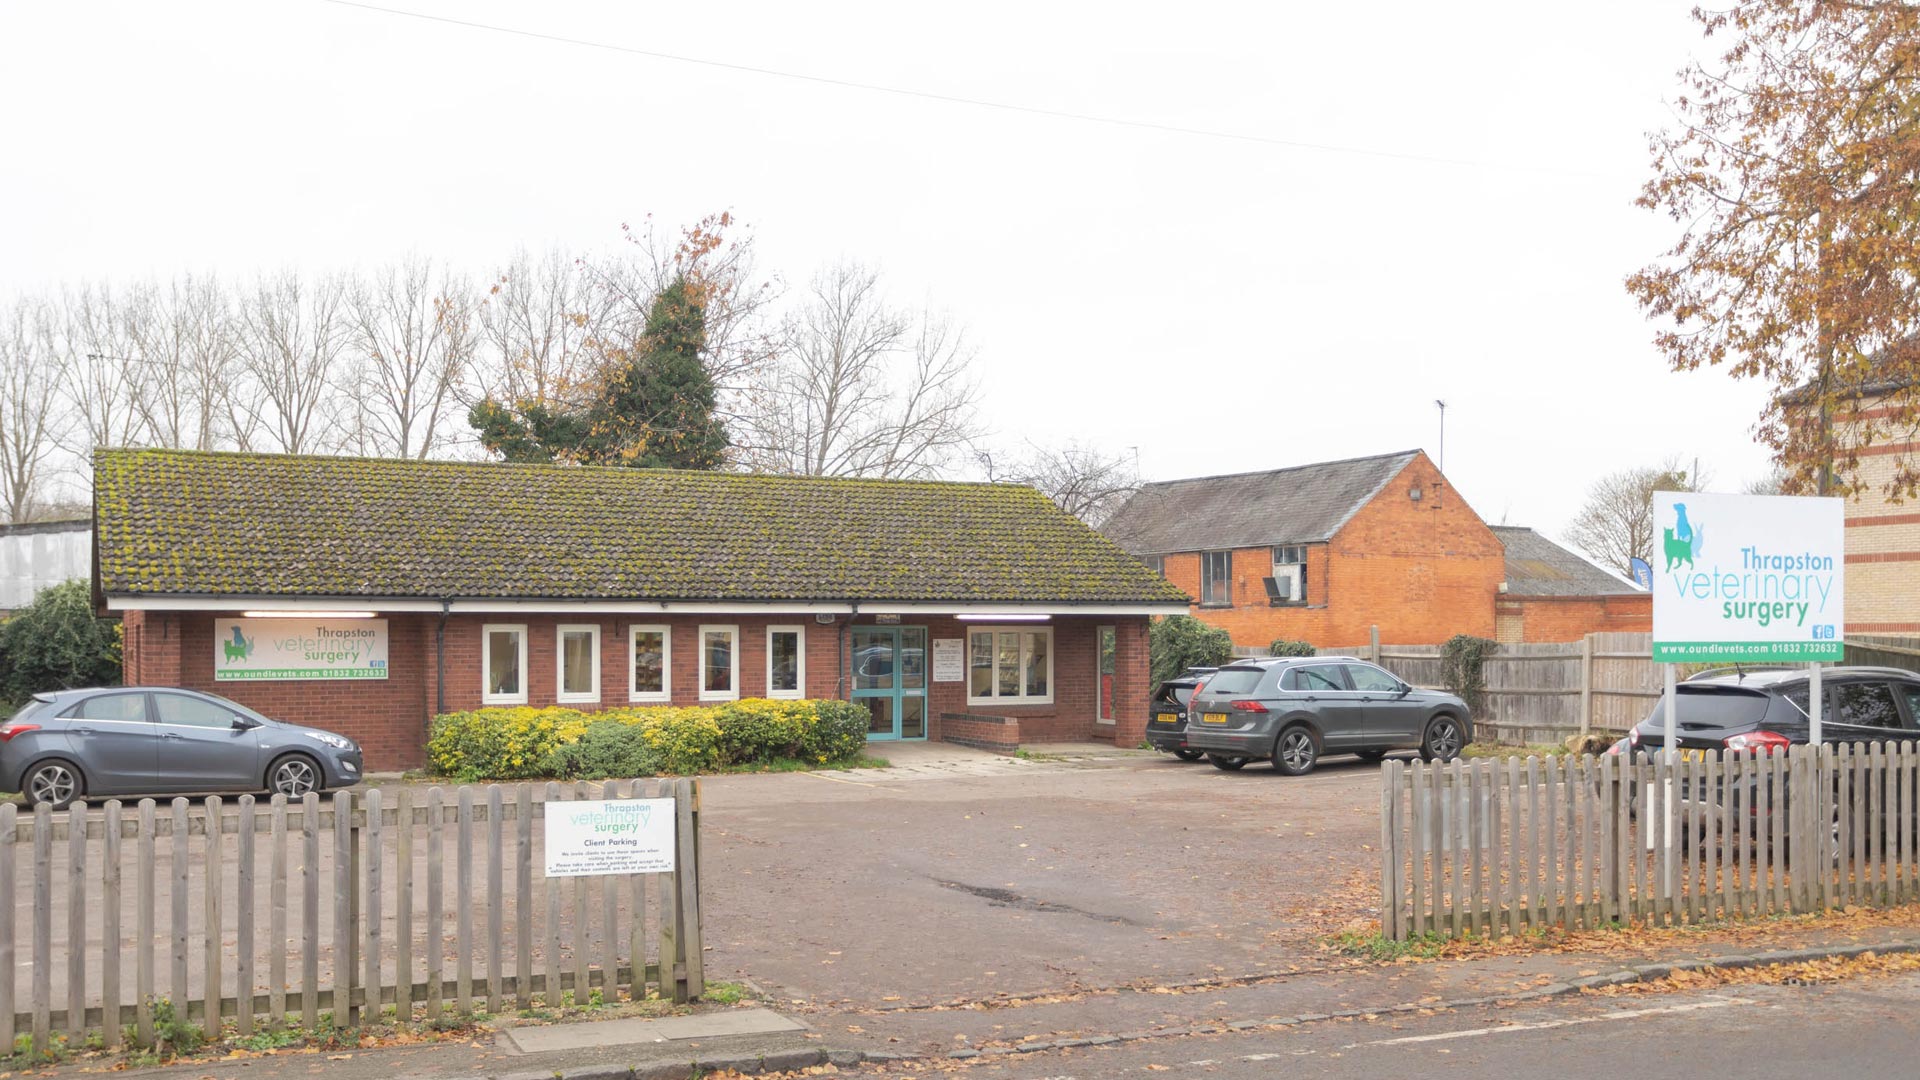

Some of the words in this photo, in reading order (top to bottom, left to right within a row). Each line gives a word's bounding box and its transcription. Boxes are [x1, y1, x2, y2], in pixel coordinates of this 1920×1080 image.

[1741, 546, 1833, 574] Thrapston
[1674, 565, 1833, 613] veterinary
[1723, 601, 1809, 627] surgery
[316, 626, 376, 639] Thrapston
[273, 634, 376, 658] veterinary
[1661, 645, 1769, 654] www.oundlevets.com
[1772, 644, 1800, 653] 01832
[1804, 644, 1838, 653] 732632
[304, 650, 360, 664] surgery
[217, 670, 320, 679] www.oundlevets.com
[322, 669, 350, 678] 01832
[604, 803, 651, 813] Thrapston
[570, 811, 650, 827] veterinary
[594, 823, 638, 834] surgery
[609, 838, 638, 846] Parking
